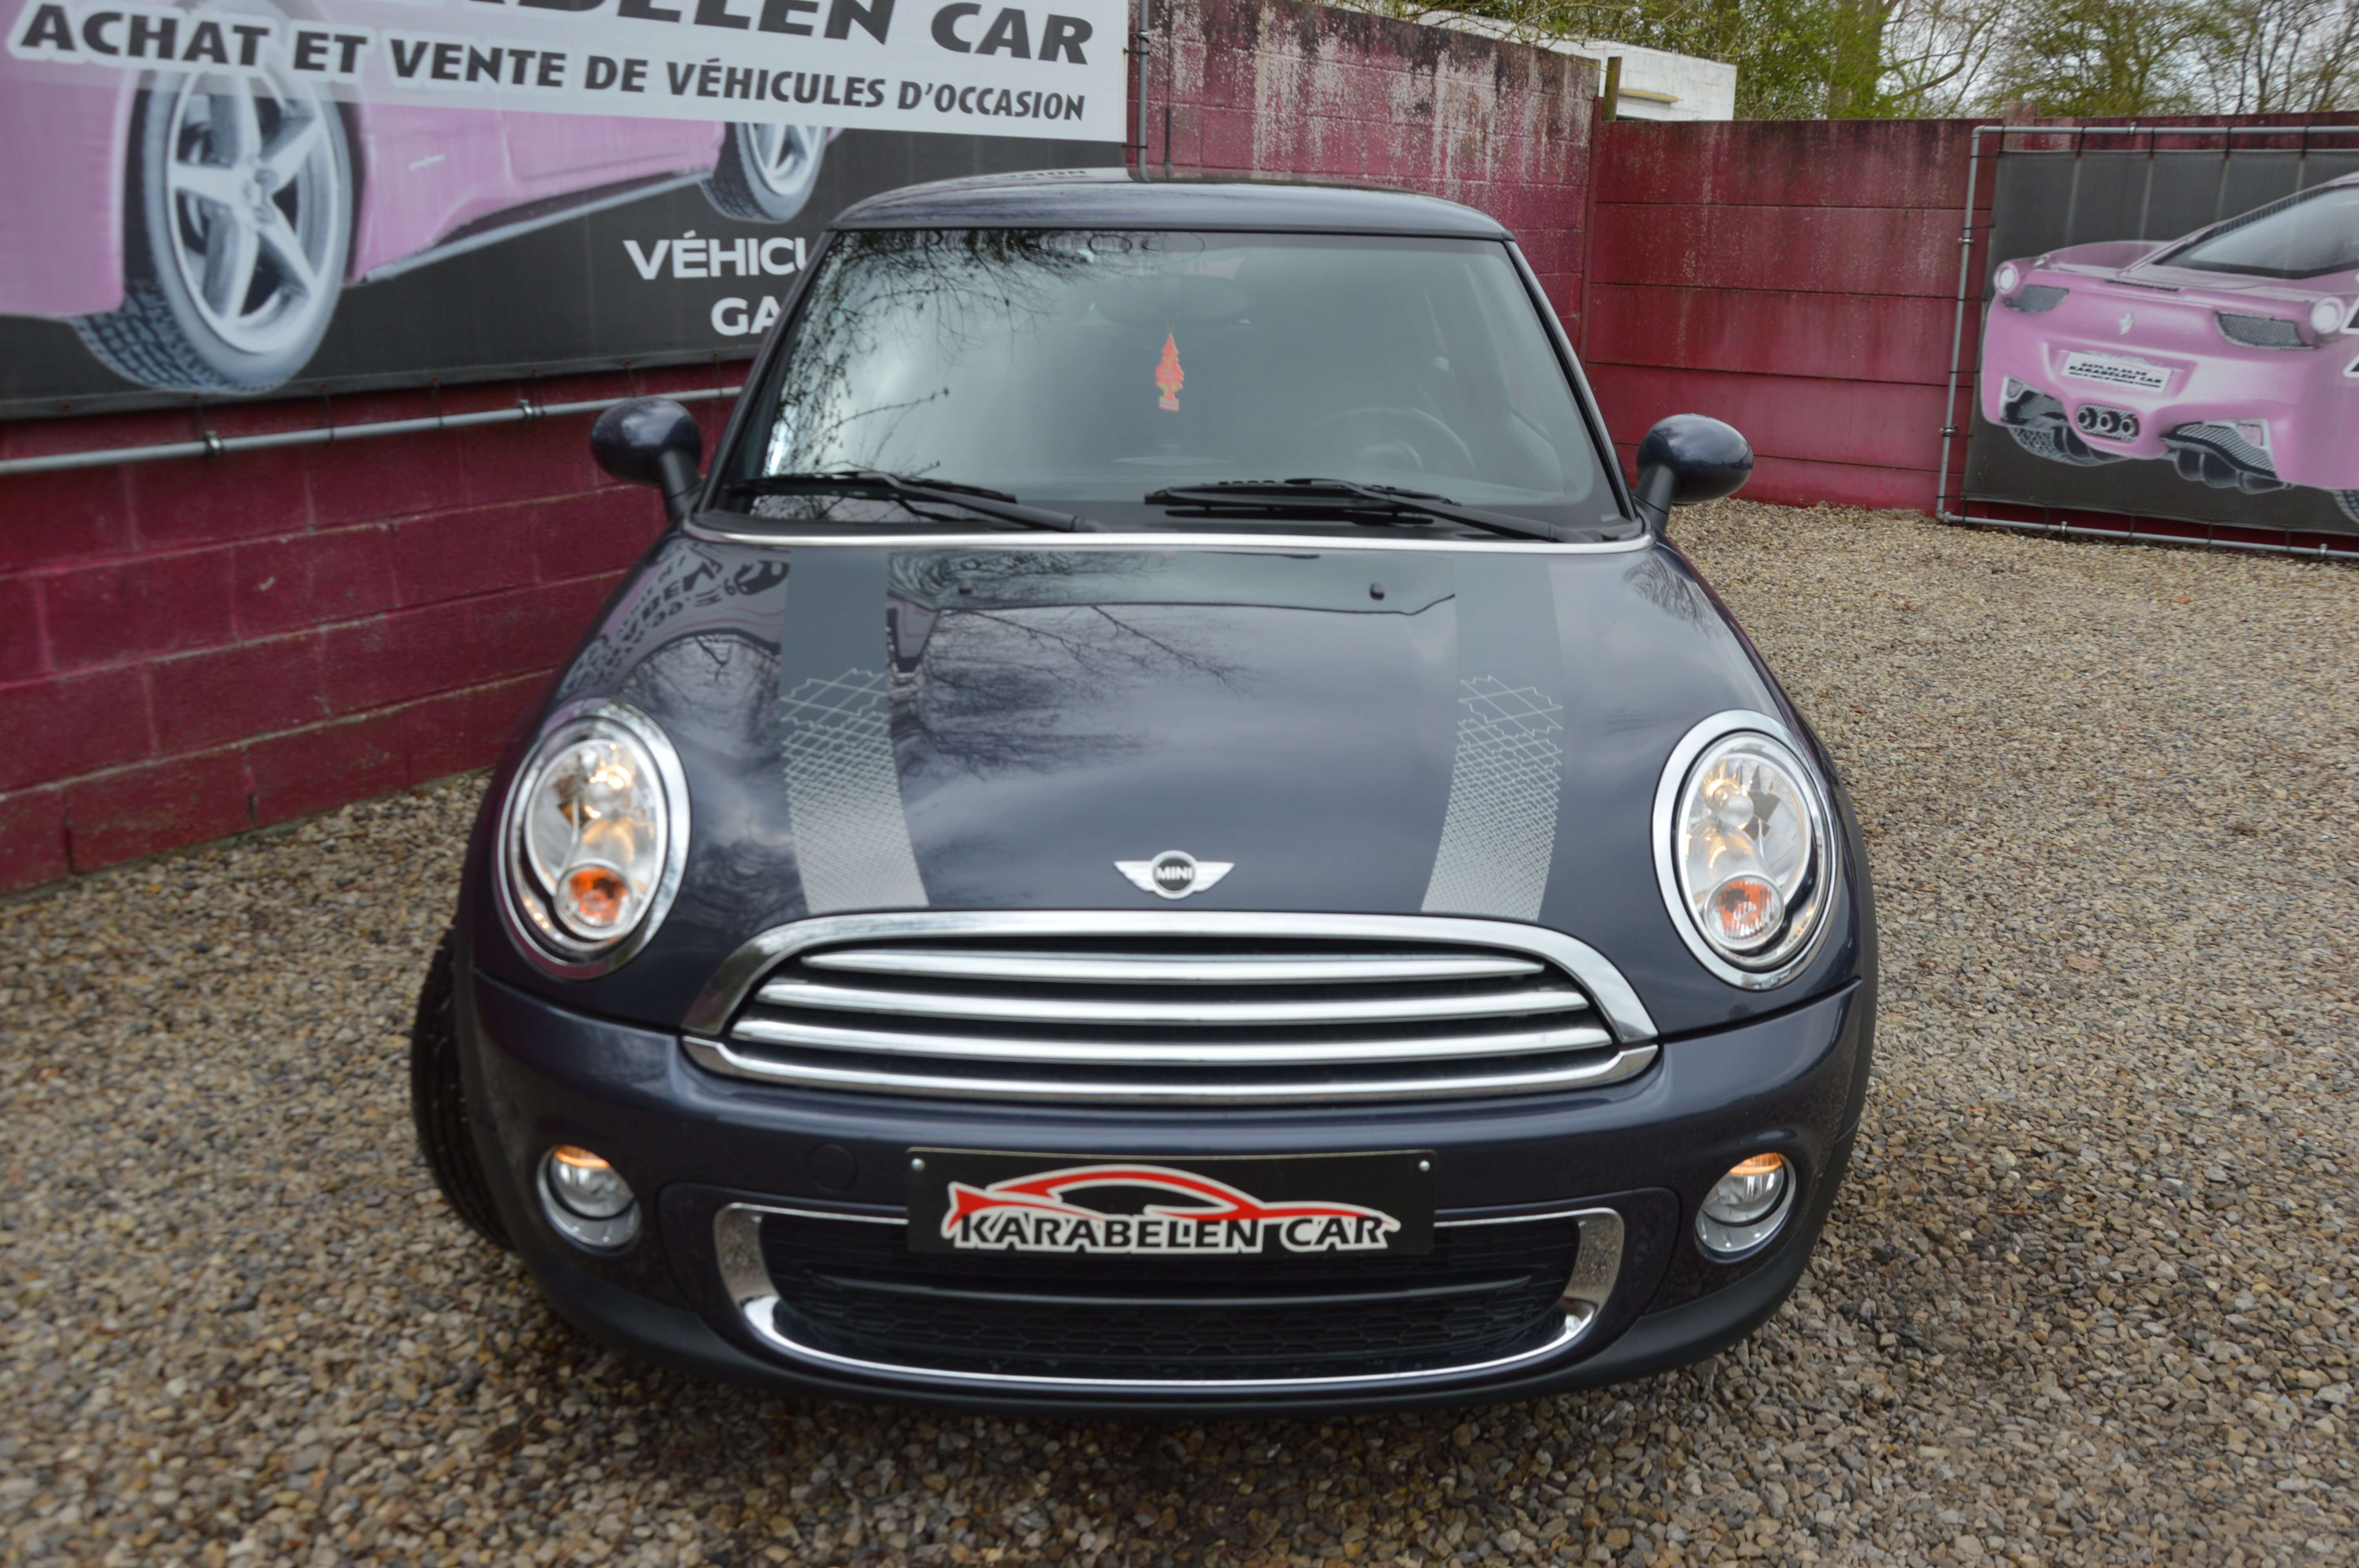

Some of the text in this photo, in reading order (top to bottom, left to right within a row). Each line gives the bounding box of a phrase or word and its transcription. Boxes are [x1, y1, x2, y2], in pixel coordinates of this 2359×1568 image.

[931, 2, 1093, 65] CAR
[20, 4, 1085, 121] ACHAT ET VENTE DE VÉHICULES D'OCCASION
[1157, 866, 1193, 881] MINI
[959, 1213, 1383, 1248] KARABELEN CAR
